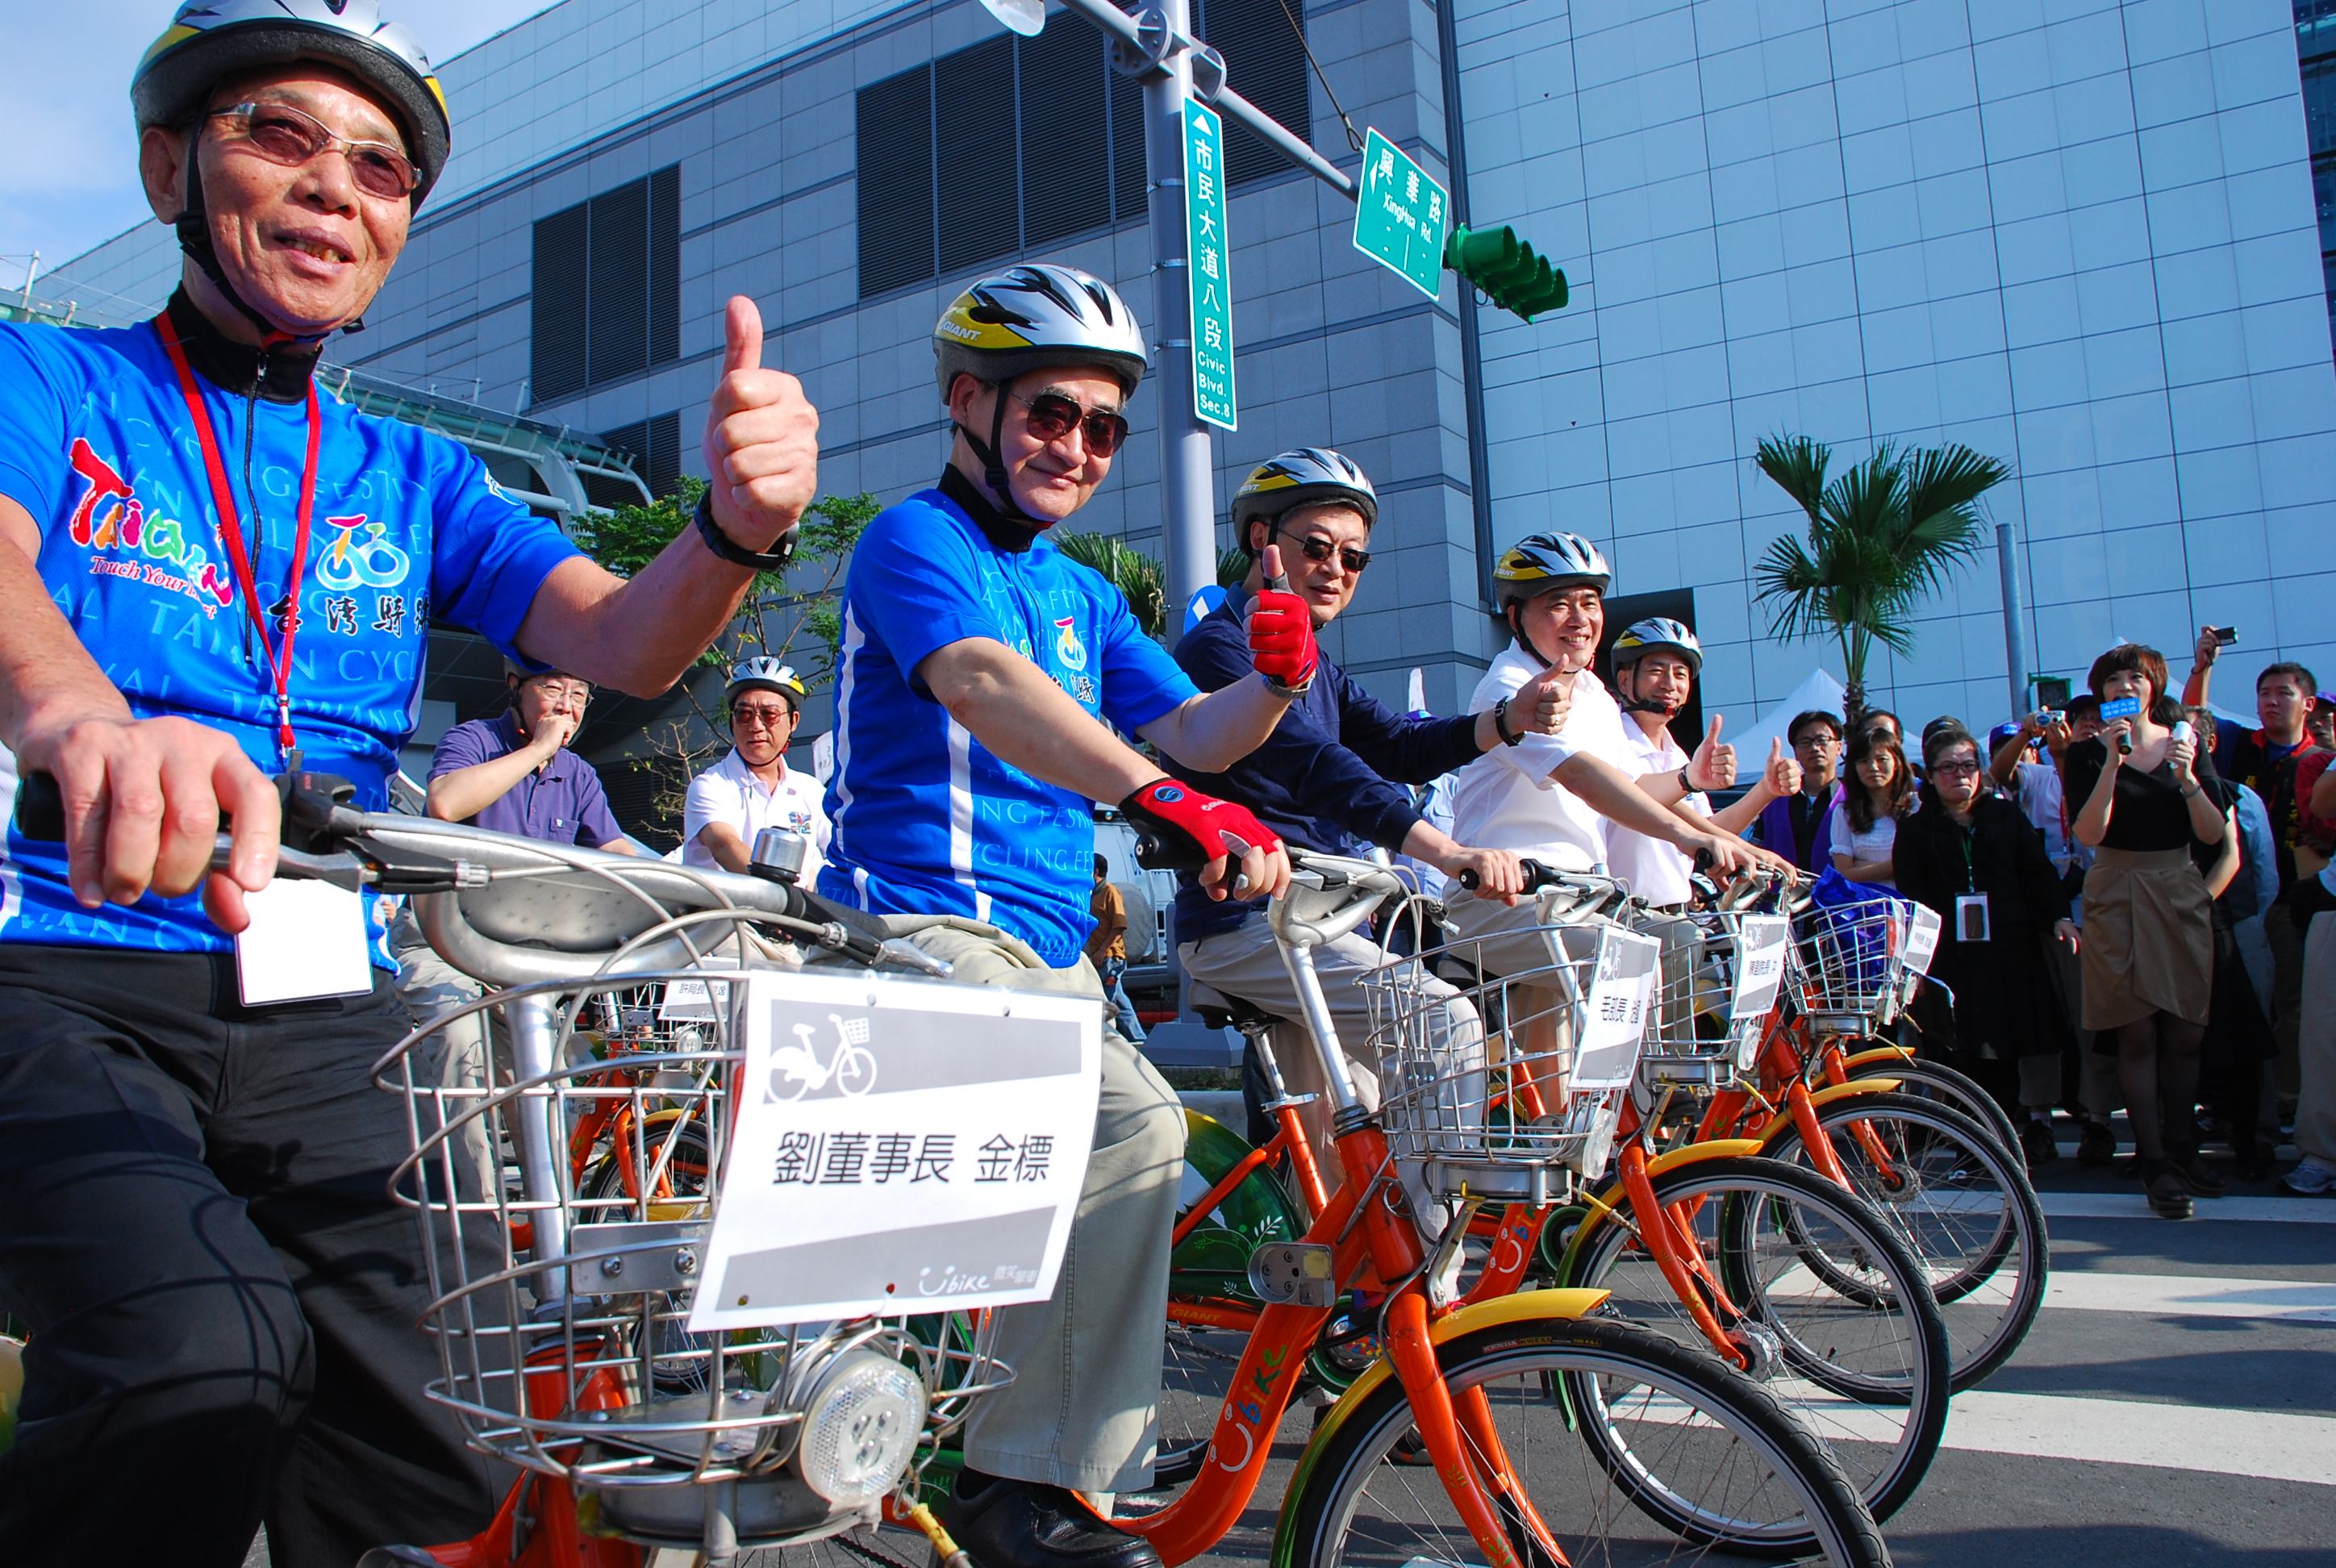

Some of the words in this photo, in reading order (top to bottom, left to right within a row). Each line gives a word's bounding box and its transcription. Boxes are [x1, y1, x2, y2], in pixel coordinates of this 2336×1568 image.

[1378, 148, 1441, 226] 興華路
[1194, 138, 1223, 352] 市民大道八段
[1420, 221, 1433, 244] Rd.
[943, 320, 982, 341] GIANT
[1197, 350, 1226, 375] Civic
[1198, 372, 1228, 397] Blvd.
[1199, 394, 1230, 418] Sec.8
[90, 556, 141, 579] Touch
[142, 564, 188, 593] Your
[773, 1131, 957, 1184] 劉董事長
[974, 1132, 1055, 1182] 金標
[1171, 1308, 1221, 1322] GIANT
[1483, 1339, 1518, 1353] KENDA
